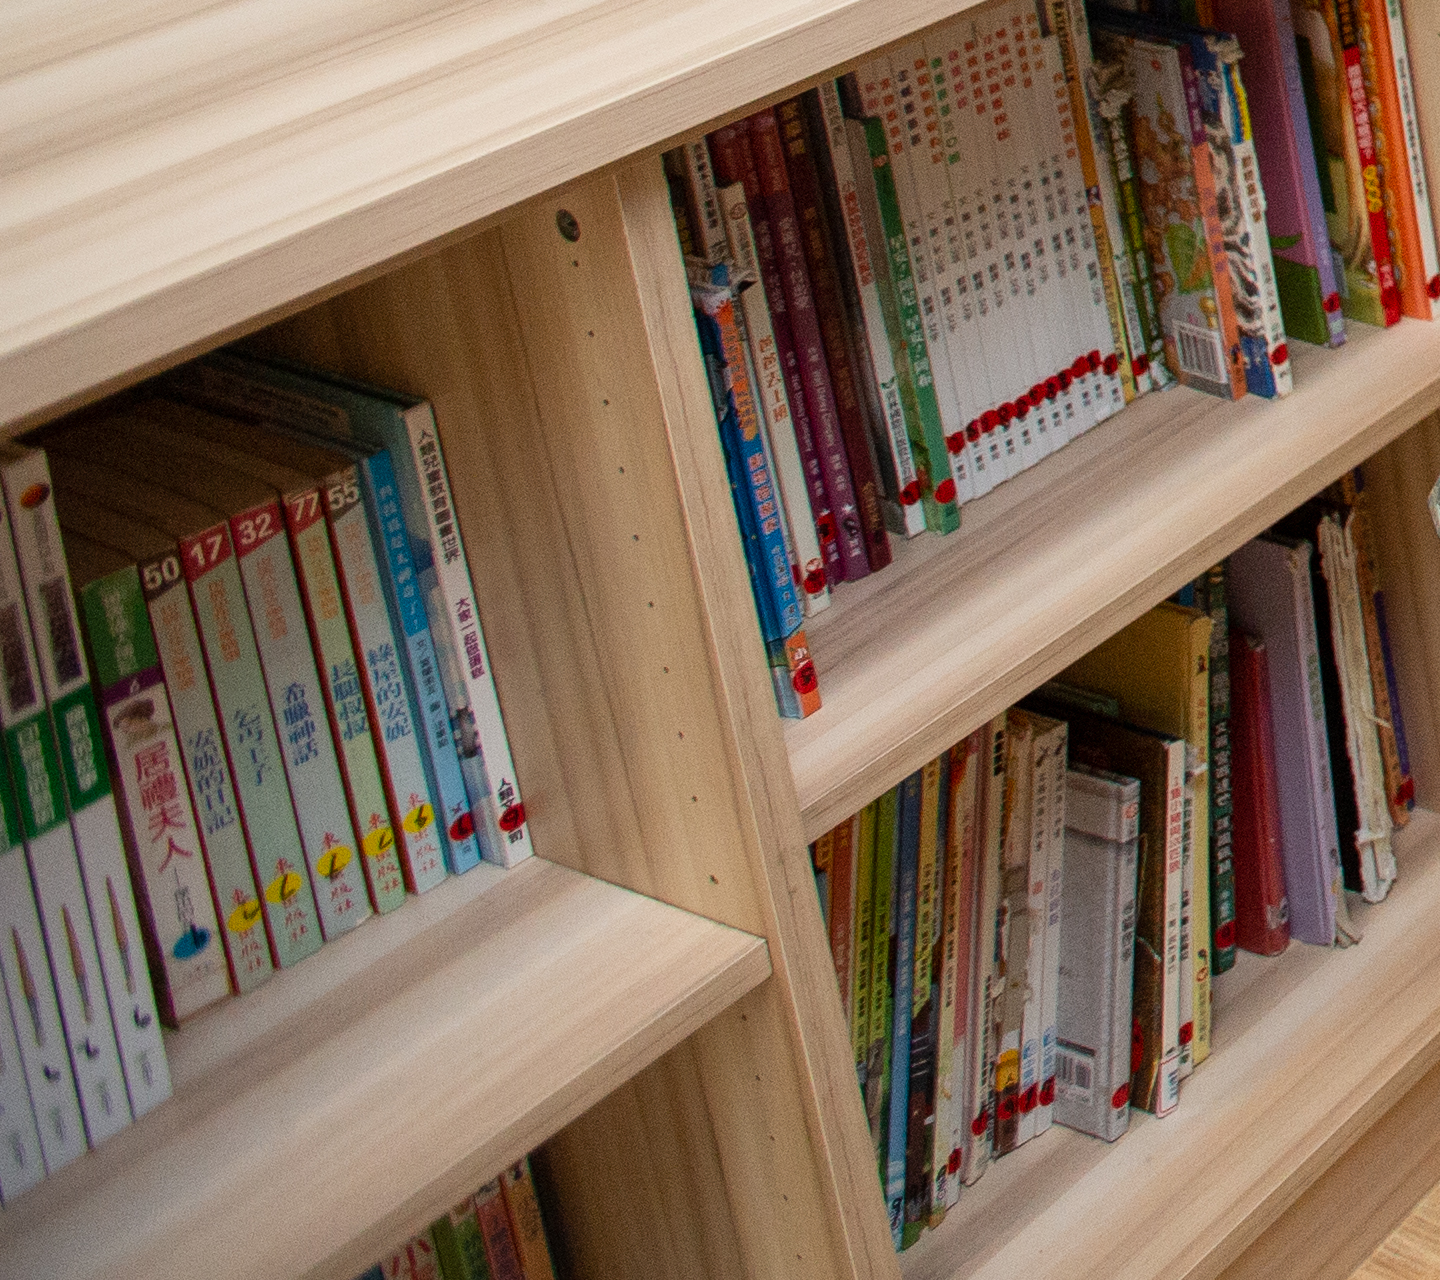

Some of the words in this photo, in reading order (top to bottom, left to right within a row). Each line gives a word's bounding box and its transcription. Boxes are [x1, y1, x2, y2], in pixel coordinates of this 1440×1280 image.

[294, 491, 321, 521] 77
[330, 481, 359, 510] 55
[238, 512, 274, 545] 32
[190, 533, 224, 567] 17
[143, 556, 181, 590] 50
[283, 681, 318, 767] 希臘神話
[188, 727, 235, 835] 安妮的日記
[134, 740, 193, 873] 居禮夫人
